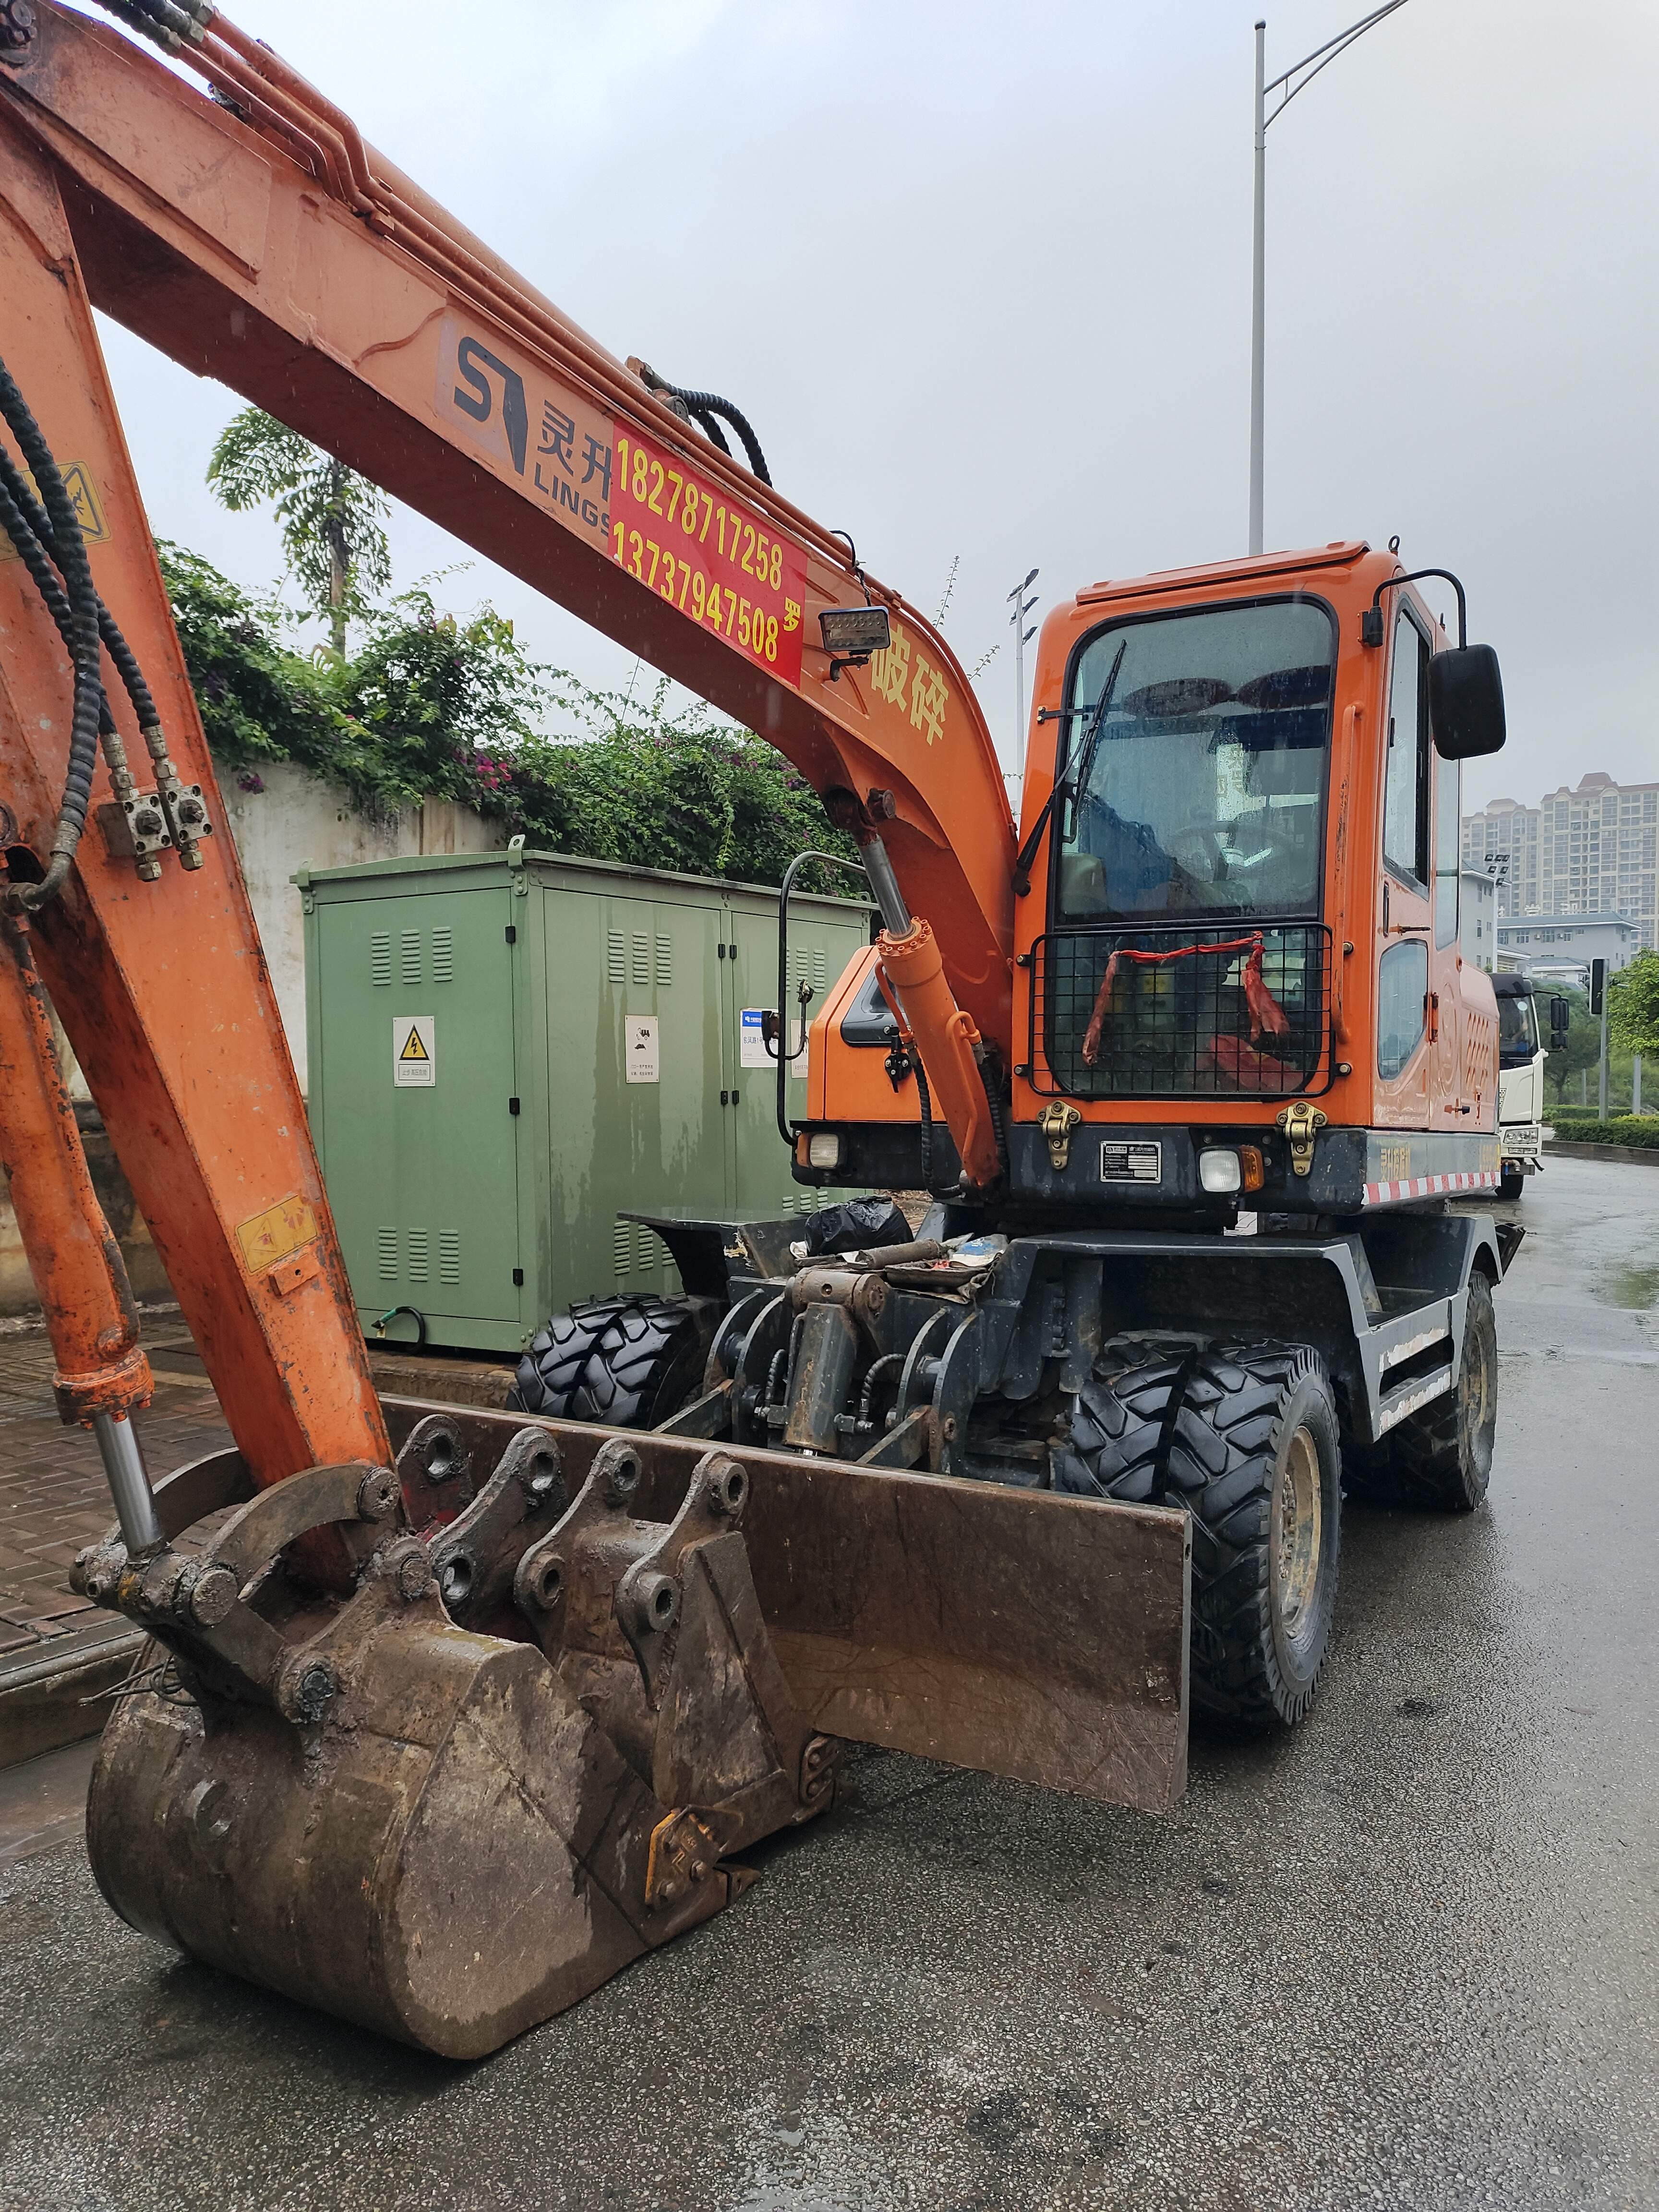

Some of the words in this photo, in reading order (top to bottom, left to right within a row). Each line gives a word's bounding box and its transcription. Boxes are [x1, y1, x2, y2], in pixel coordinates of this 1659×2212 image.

[537, 399, 612, 503] 灵升
[617, 438, 783, 591] 18278717258
[612, 520, 779, 663] 13737947508
[783, 597, 801, 632] 罗
[869, 623, 949, 746] 破碎
